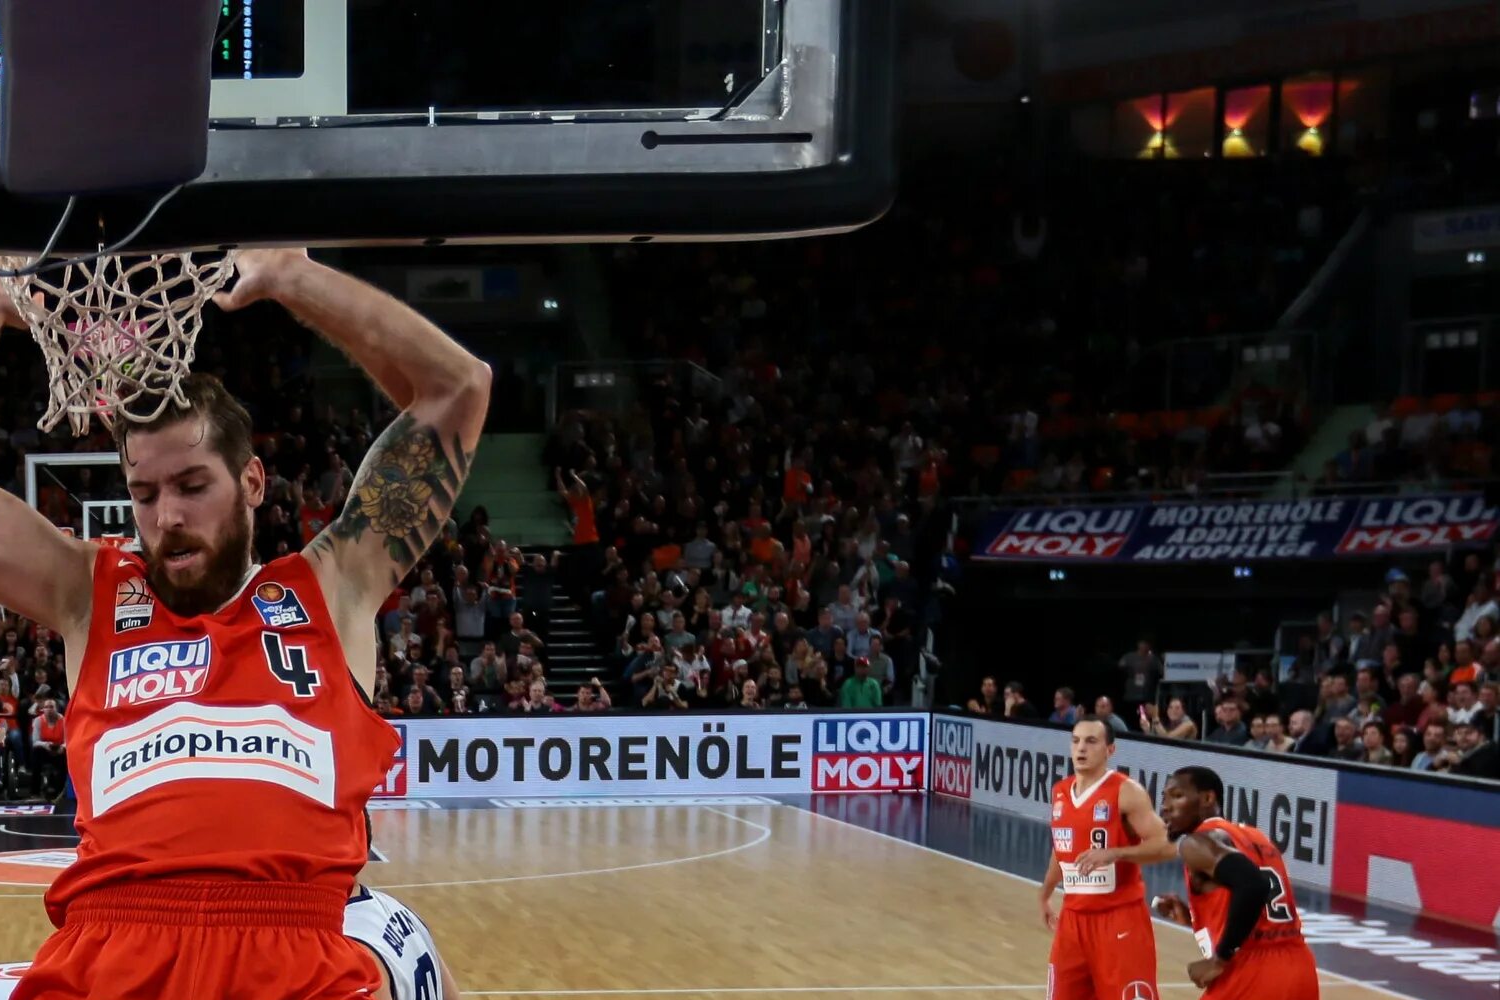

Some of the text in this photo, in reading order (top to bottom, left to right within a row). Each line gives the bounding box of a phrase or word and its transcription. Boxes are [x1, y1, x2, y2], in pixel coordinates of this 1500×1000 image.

[1013, 510, 1135, 533] LIQUI
[1167, 524, 1306, 544] ADDITIVE
[1347, 523, 1488, 551] MOLY
[996, 535, 1127, 556] MOLY
[1133, 541, 1317, 560] AUTOPFLEGE
[122, 618, 141, 629] ulm
[269, 611, 304, 626] BBL
[115, 641, 207, 680] LIQUI
[261, 630, 322, 698] 4
[111, 668, 206, 708] MOLY
[817, 720, 918, 752] LIQUI
[935, 721, 973, 758] LIQUI
[108, 730, 312, 780] ratiopharm
[418, 723, 802, 783] MOTORENÖLE
[817, 756, 923, 789] MOLY
[935, 759, 973, 799] MOLY
[1090, 827, 1108, 850] 9
